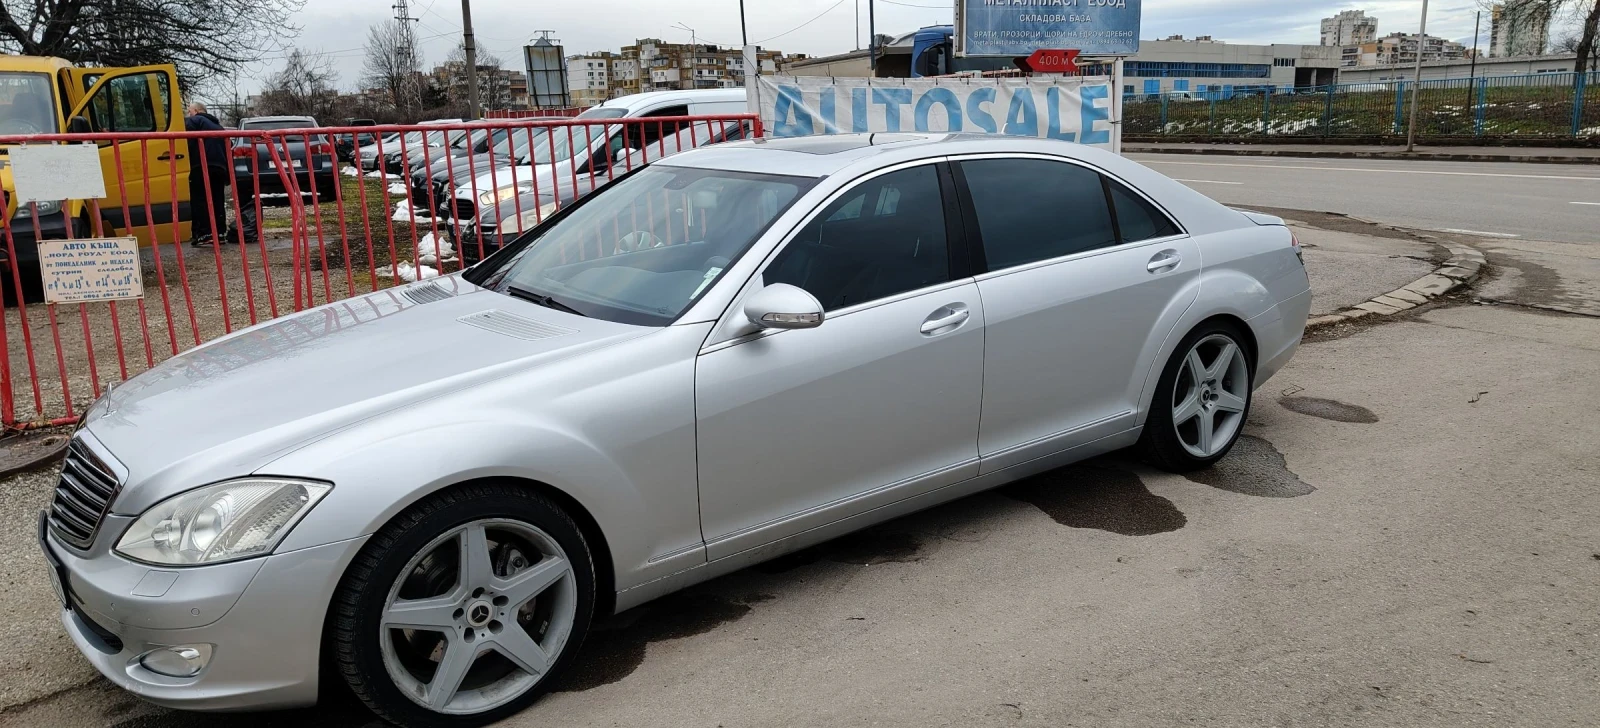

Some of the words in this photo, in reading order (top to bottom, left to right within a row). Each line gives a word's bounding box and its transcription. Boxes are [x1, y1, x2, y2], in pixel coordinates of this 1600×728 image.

[1019, 14, 1066, 23] СКЛАДОВА
[1069, 14, 1091, 22] БАЗА
[1039, 56, 1058, 65] 400
[773, 86, 1110, 143] AUTOSALE
